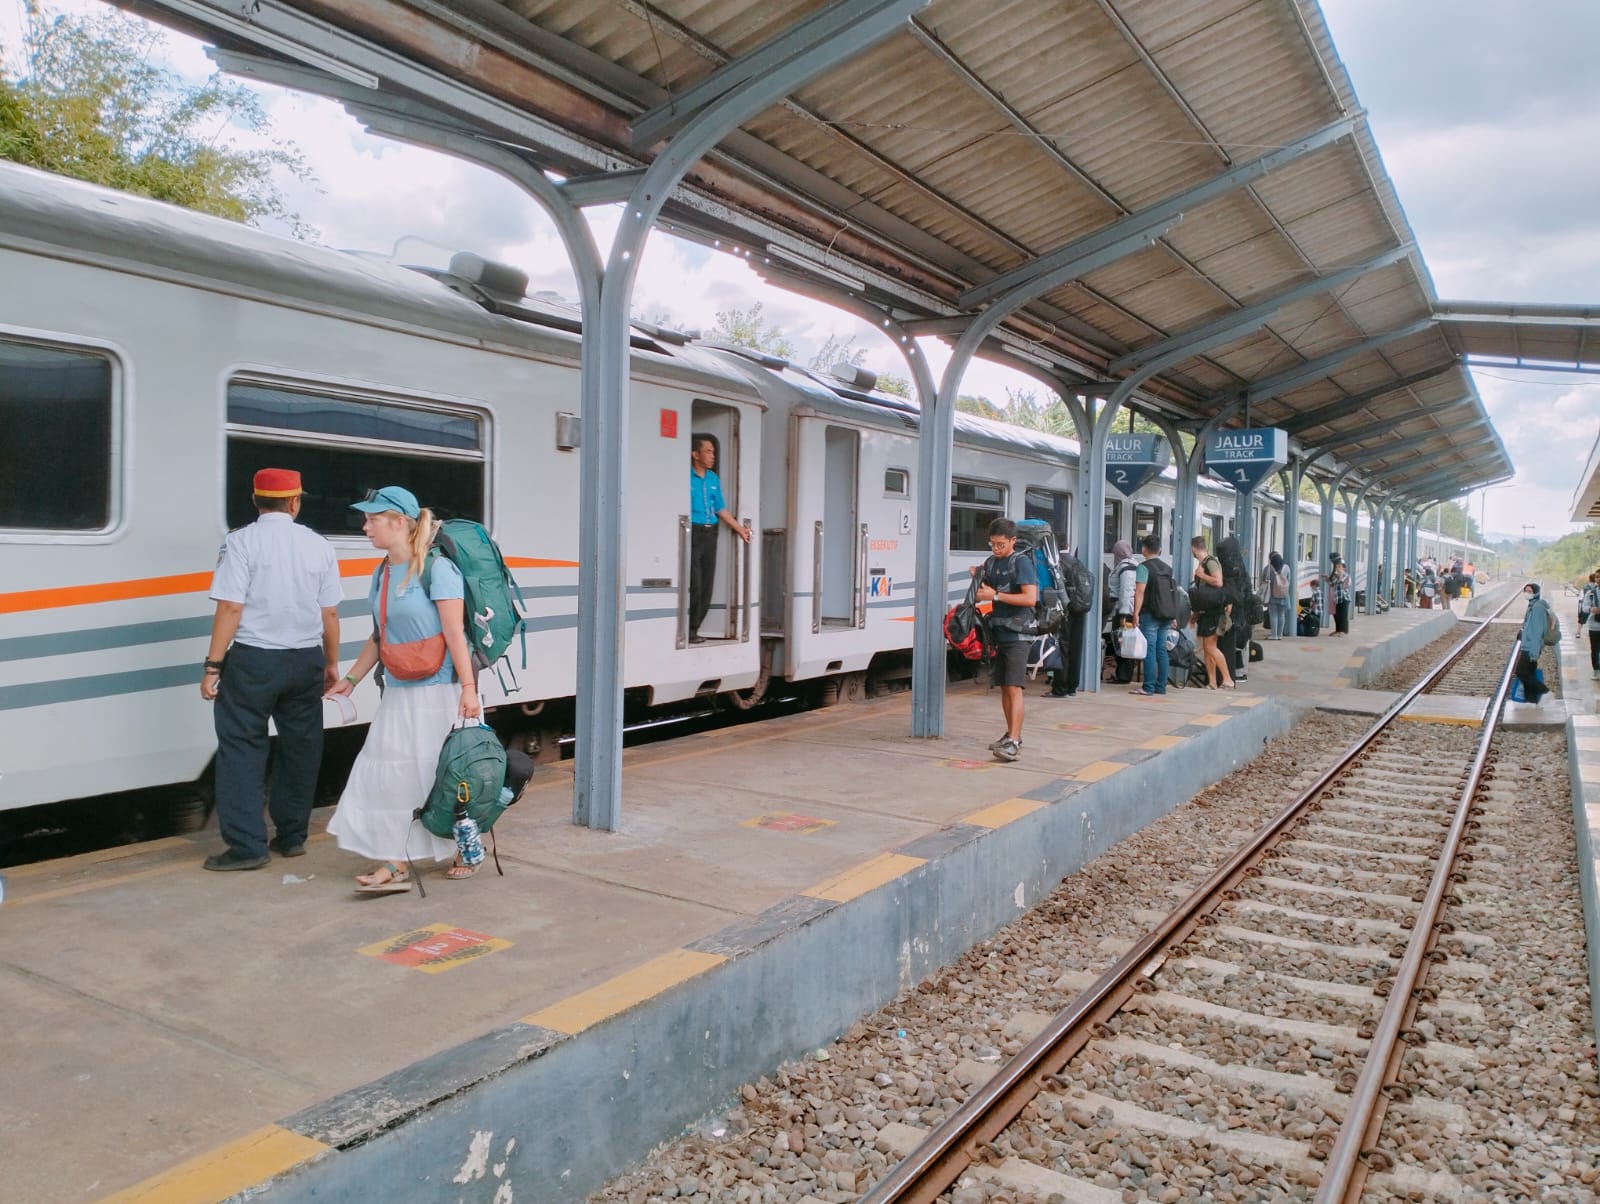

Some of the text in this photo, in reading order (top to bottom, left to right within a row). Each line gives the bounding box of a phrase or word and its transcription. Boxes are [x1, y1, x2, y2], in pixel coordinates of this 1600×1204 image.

[1105, 438, 1142, 451] ALUR
[1215, 434, 1264, 449] JALUR
[1223, 450, 1255, 459] TRACK
[1115, 469, 1129, 484] 2
[1235, 468, 1250, 482] 1
[903, 514, 909, 529] 2
